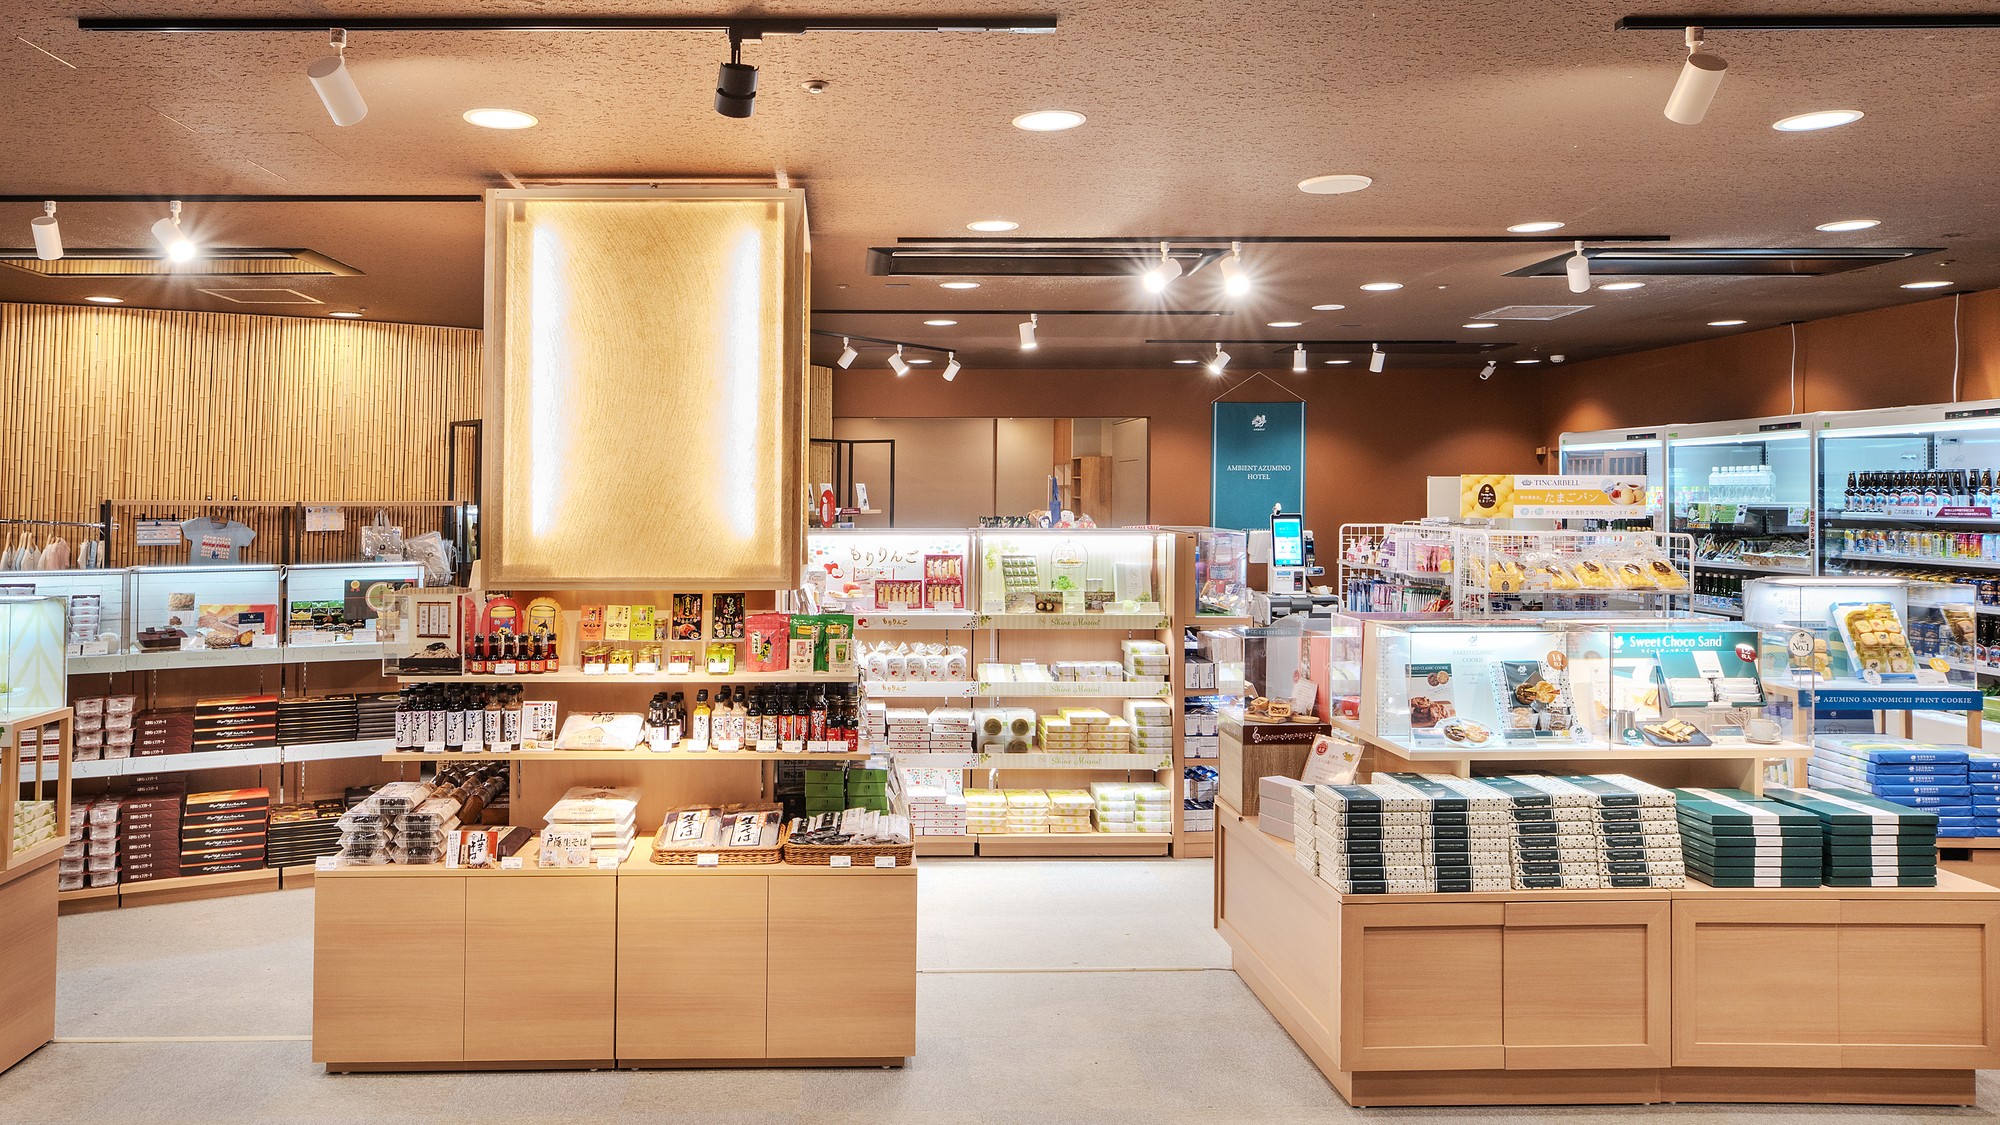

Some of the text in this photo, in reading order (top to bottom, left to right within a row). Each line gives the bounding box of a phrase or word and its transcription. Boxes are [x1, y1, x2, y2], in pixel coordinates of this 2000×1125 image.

[1545, 492, 1600, 503] たまごパン
[850, 545, 919, 568] もりりんご
[882, 617, 907, 626] もりりんご
[1051, 618, 1101, 626] Shine Muscat
[1630, 635, 1722, 647] Sweet Choco Sand
[1792, 643, 1809, 651] No.1
[1552, 654, 1561, 662] 14
[882, 684, 907, 692] もりりんご
[1051, 684, 1101, 693] Shine Muscat
[1052, 756, 1071, 764] Shine
[680, 814, 698, 837] 生そば
[738, 816, 756, 842] 生そば
[546, 834, 588, 848] 戸隠生そば
